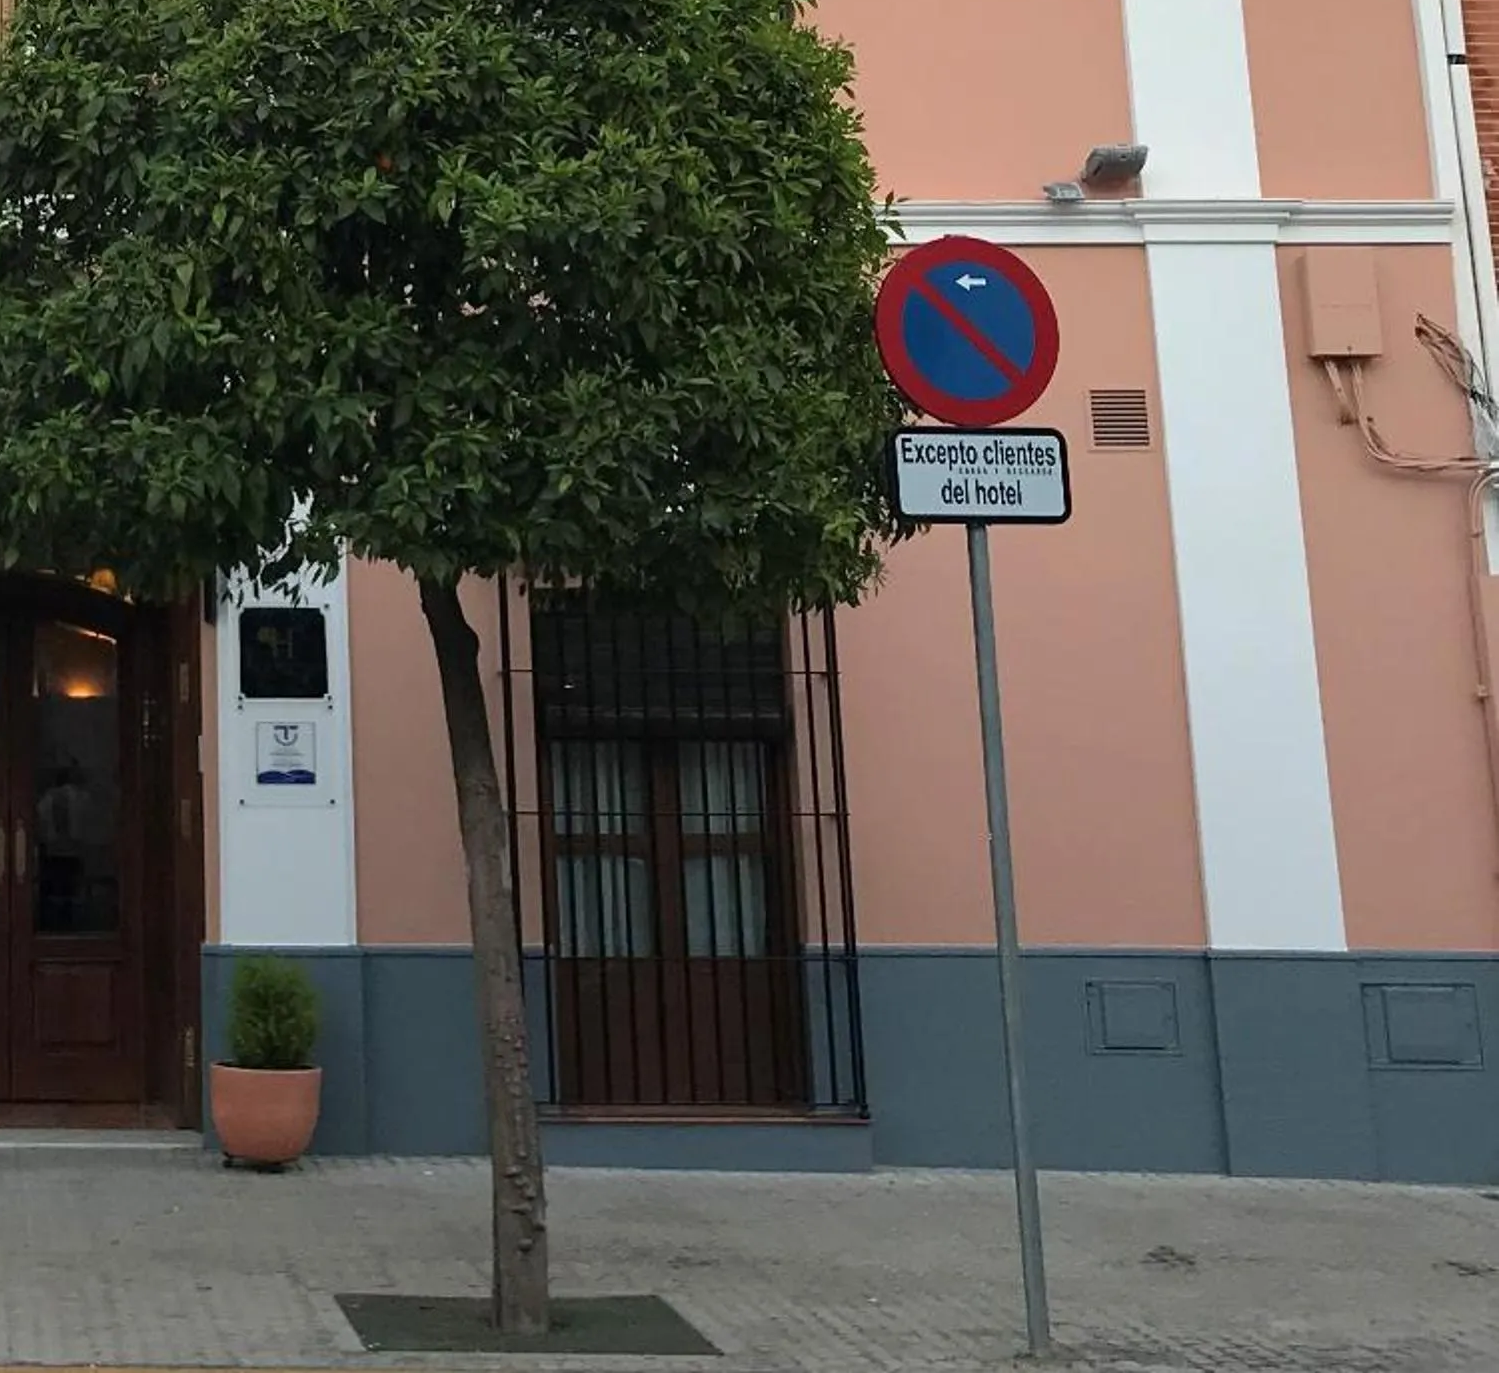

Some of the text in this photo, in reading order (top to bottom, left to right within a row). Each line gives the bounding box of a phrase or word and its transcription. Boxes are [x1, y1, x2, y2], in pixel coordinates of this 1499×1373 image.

[901, 438, 1057, 470] Excepto clientes
[941, 478, 1022, 505] del hotel
